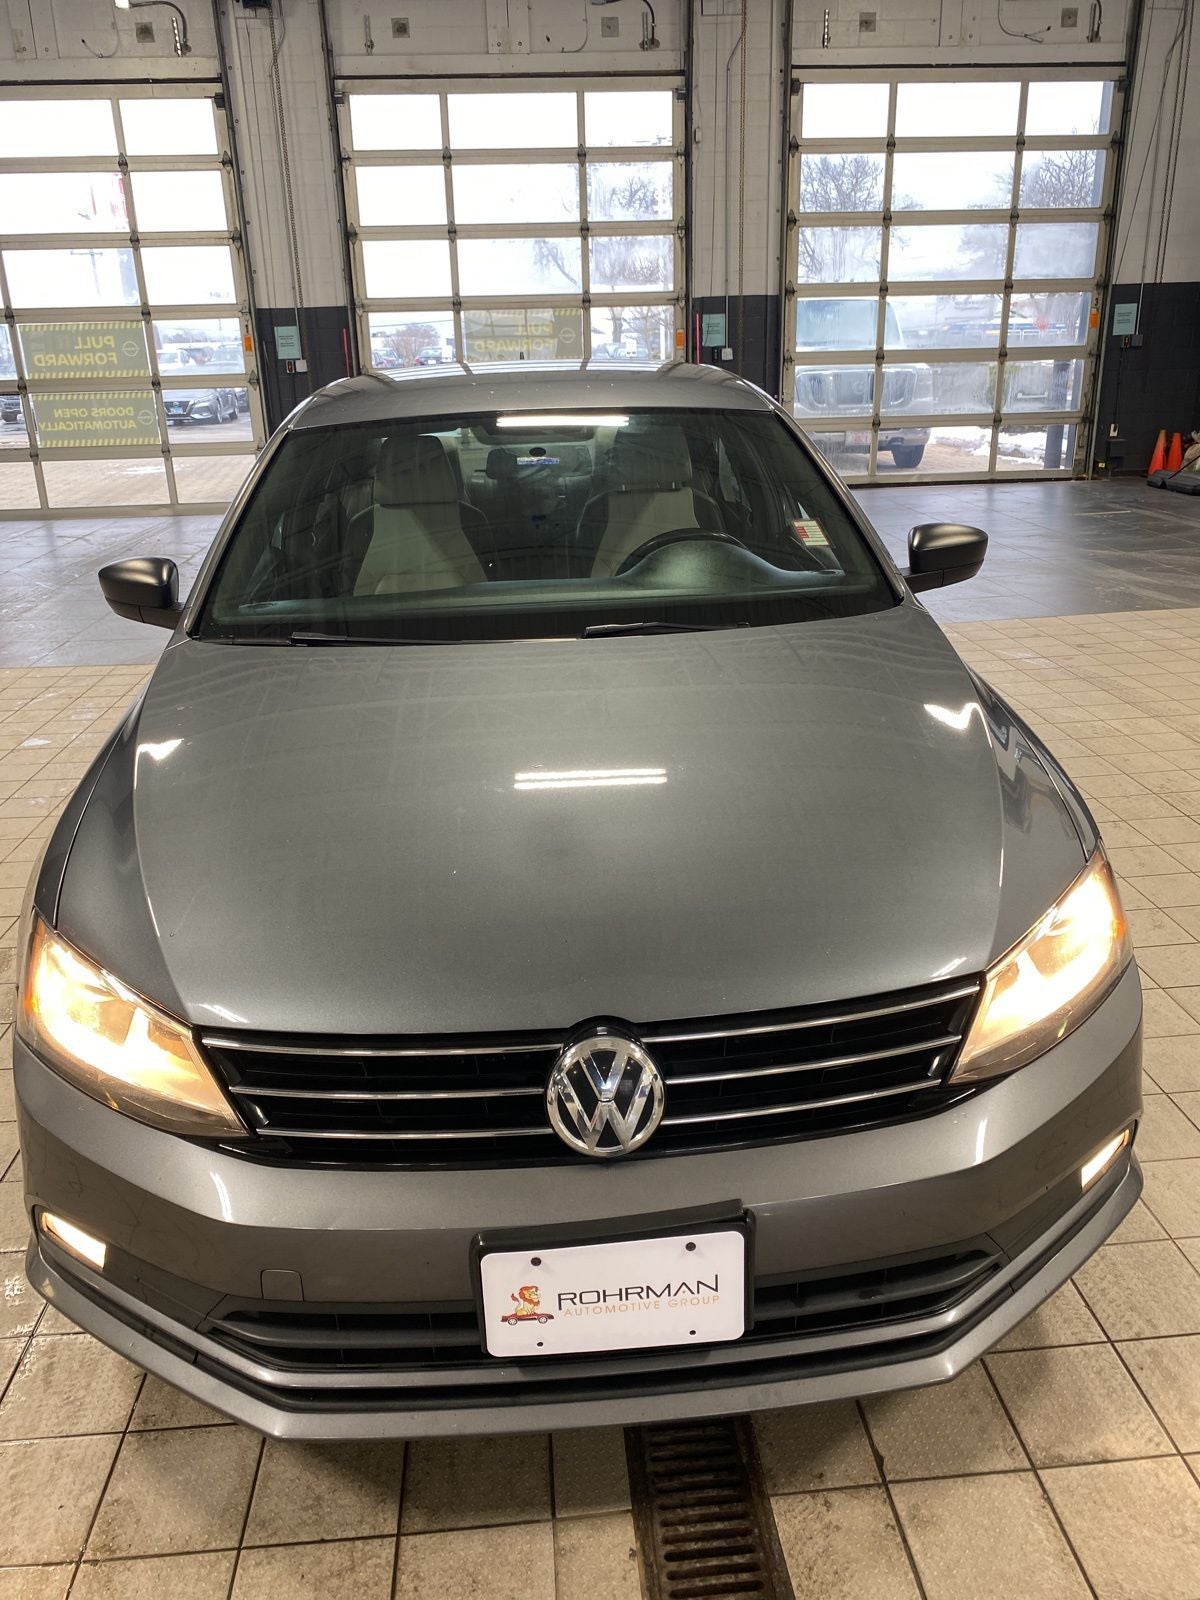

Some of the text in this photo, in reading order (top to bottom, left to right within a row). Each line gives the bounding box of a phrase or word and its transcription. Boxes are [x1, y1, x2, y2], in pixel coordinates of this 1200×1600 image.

[557, 1274, 720, 1311] ROHRMAN
[563, 1295, 721, 1317] AUTOMOTIVE GROUP
